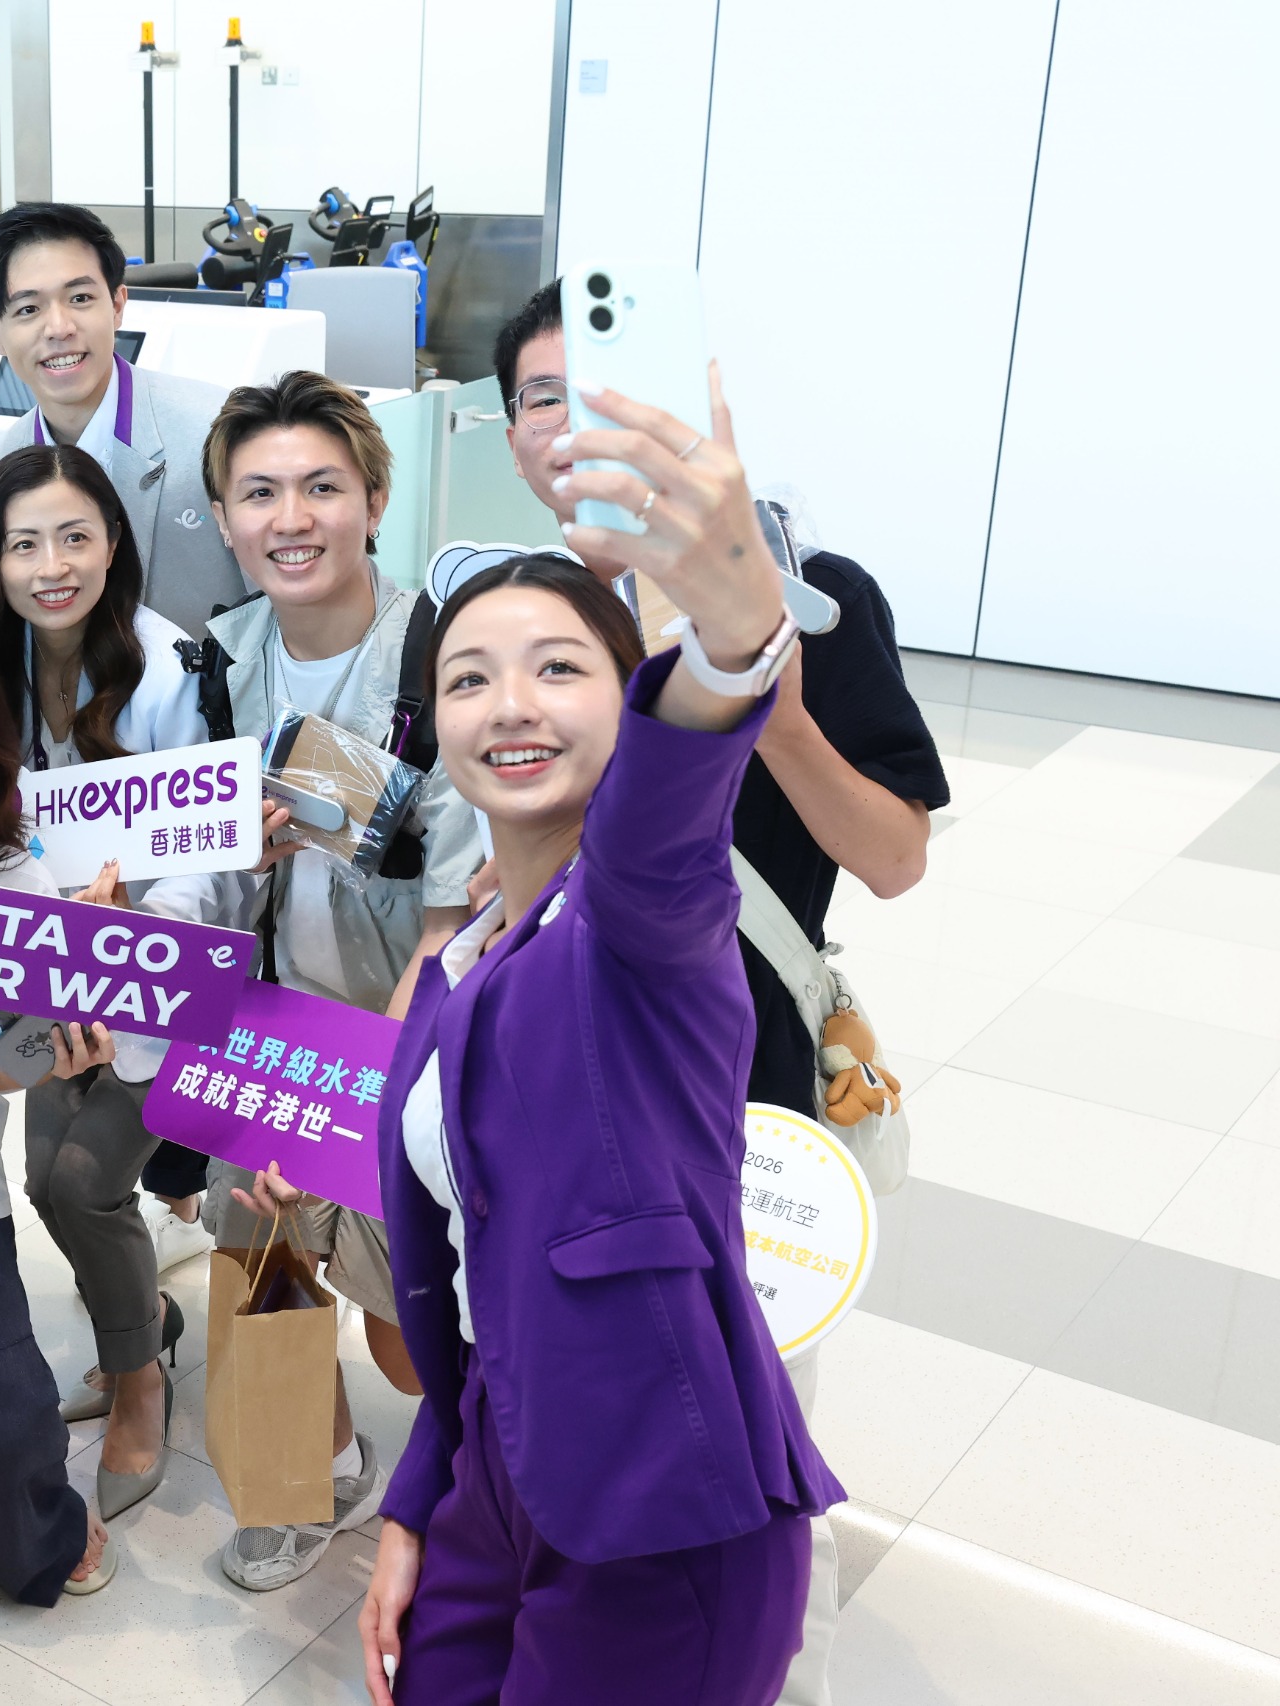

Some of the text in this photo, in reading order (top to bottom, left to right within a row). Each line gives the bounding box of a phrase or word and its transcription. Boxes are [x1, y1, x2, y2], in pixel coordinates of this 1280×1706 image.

[36, 761, 238, 829] HKexpress
[151, 820, 239, 857] 香港快運
[91, 924, 181, 974] GO
[48, 966, 191, 1027] WAY
[198, 1026, 387, 1106] 世界級水準
[172, 1062, 363, 1142] 成就香港世一
[743, 1151, 784, 1174] 2026
[753, 1281, 778, 1301] 評選
